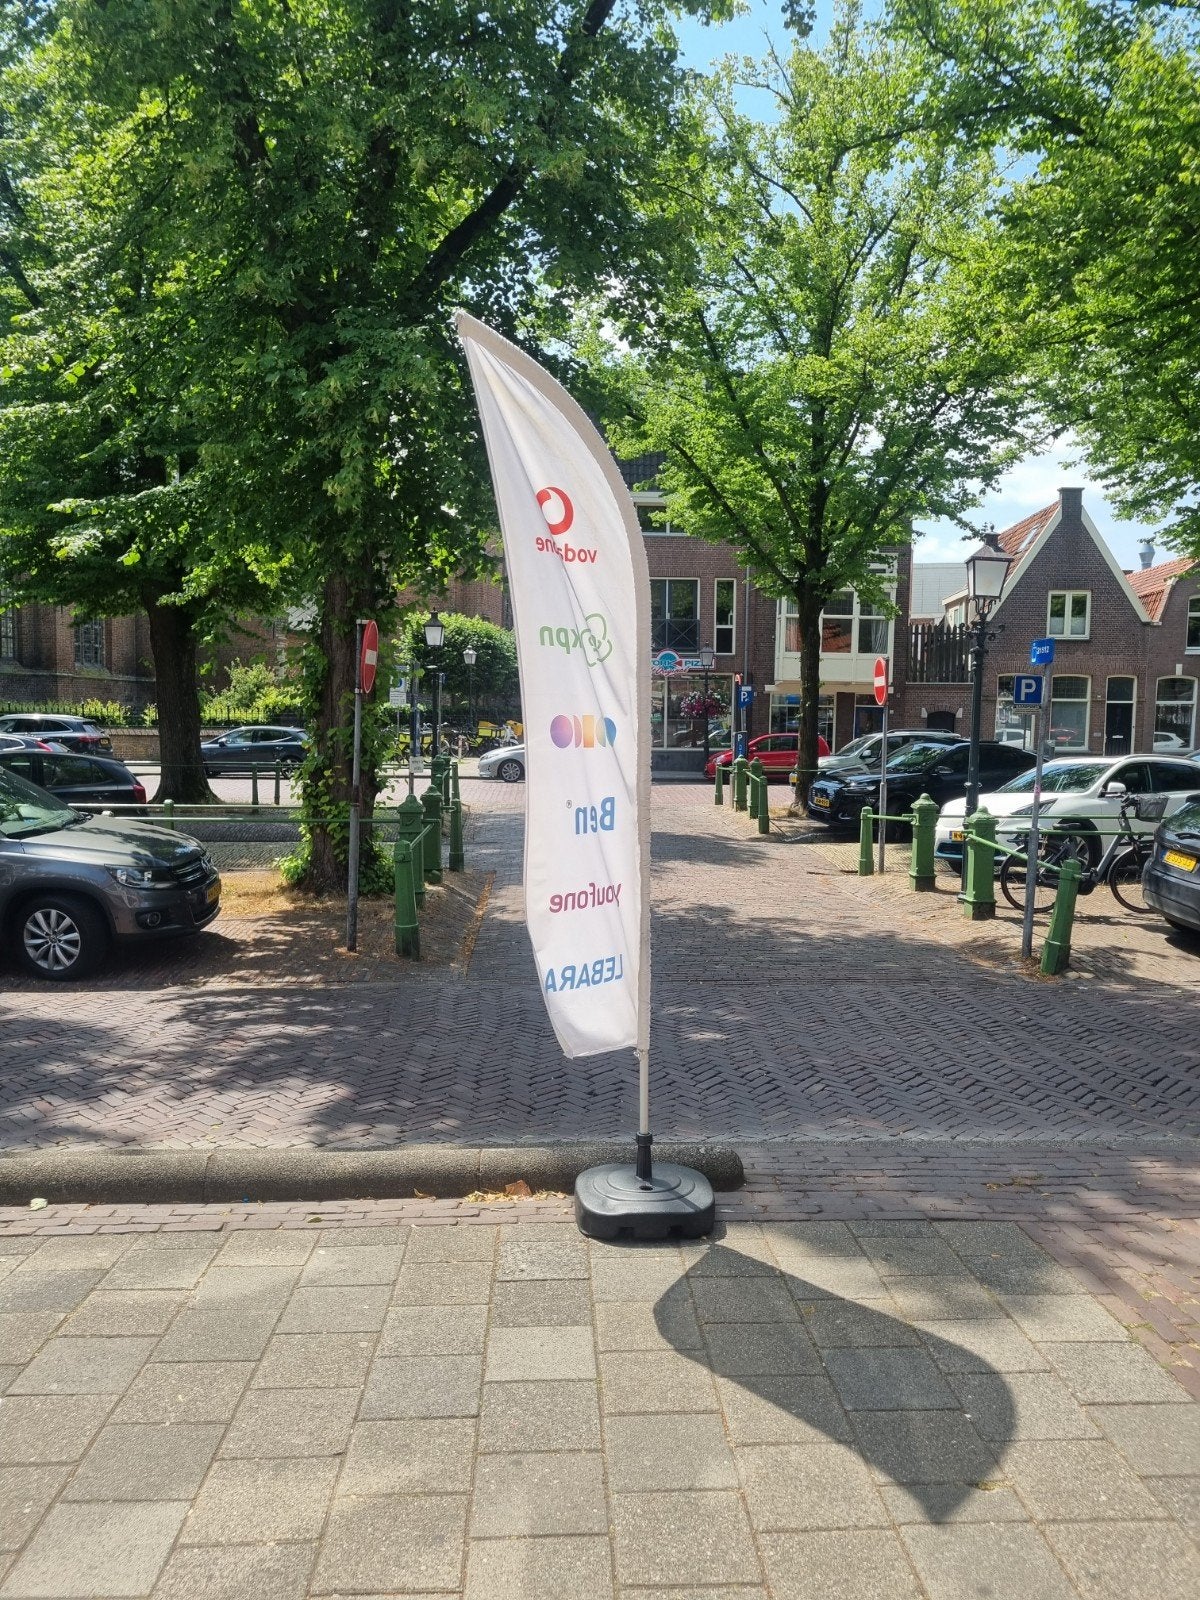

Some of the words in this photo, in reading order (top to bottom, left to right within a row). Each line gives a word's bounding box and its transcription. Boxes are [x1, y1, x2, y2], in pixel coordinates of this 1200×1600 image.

[1021, 679, 1036, 700] P
[741, 691, 748, 702] P
[737, 734, 743, 742] P
